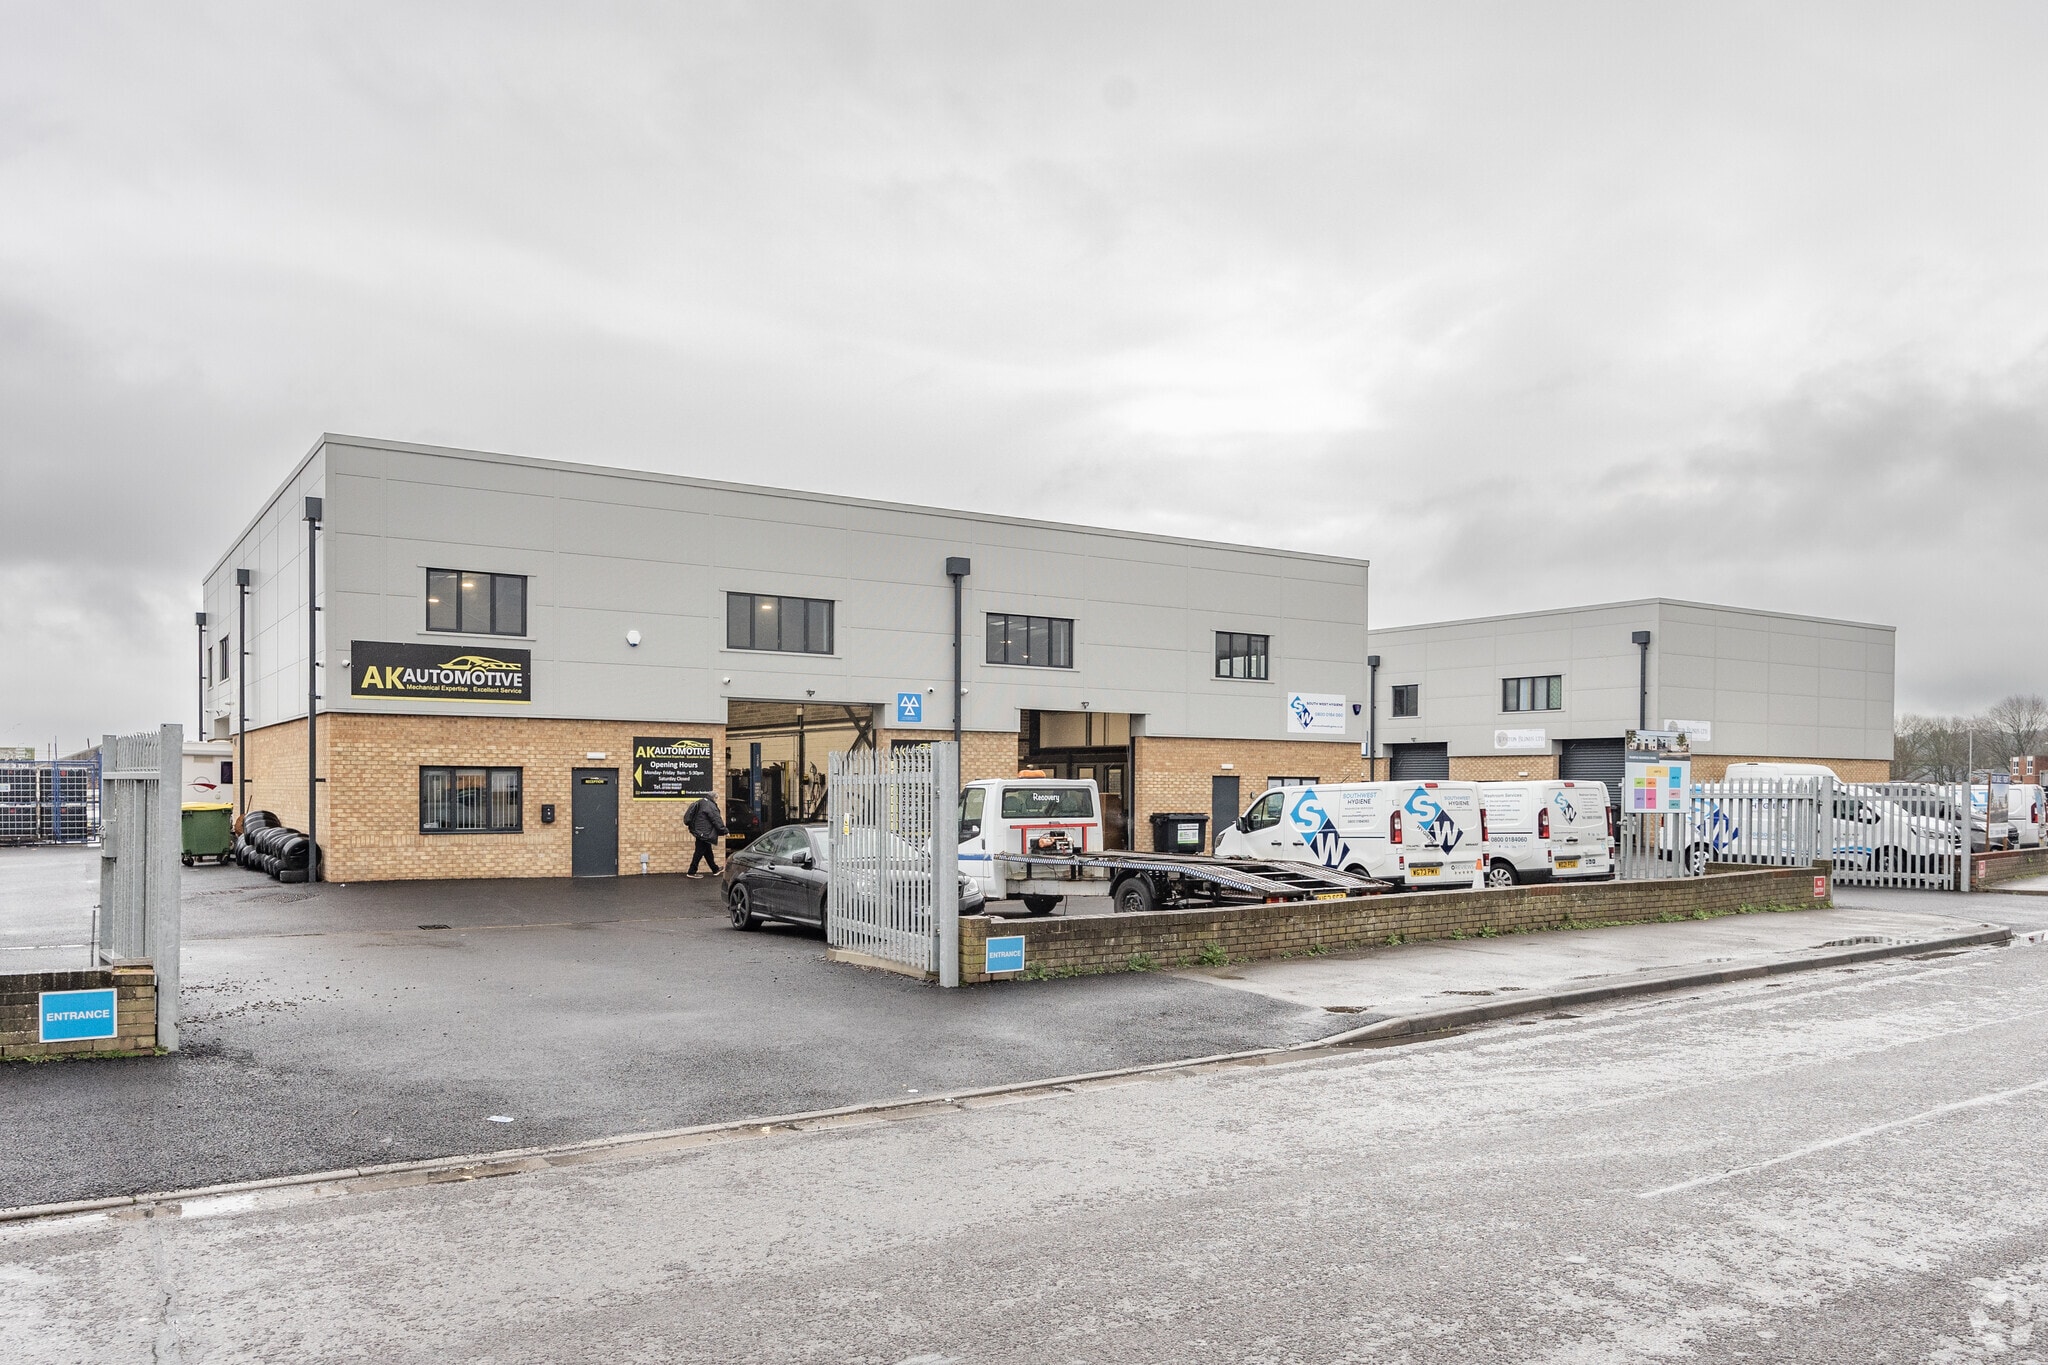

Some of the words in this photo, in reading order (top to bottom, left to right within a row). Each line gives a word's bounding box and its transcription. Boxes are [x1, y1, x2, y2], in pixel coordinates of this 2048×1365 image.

[361, 666, 405, 689] AK
[402, 668, 523, 687] AUTOMOTIVE
[441, 685, 468, 693] Expertise
[635, 746, 656, 758] AK
[654, 746, 711, 755] AUTOMOTIVE
[650, 761, 678, 769] Opening
[1032, 793, 1060, 802] Recovery
[989, 949, 1022, 959] ENTRANCE
[46, 1009, 110, 1022] ENTRANCE
